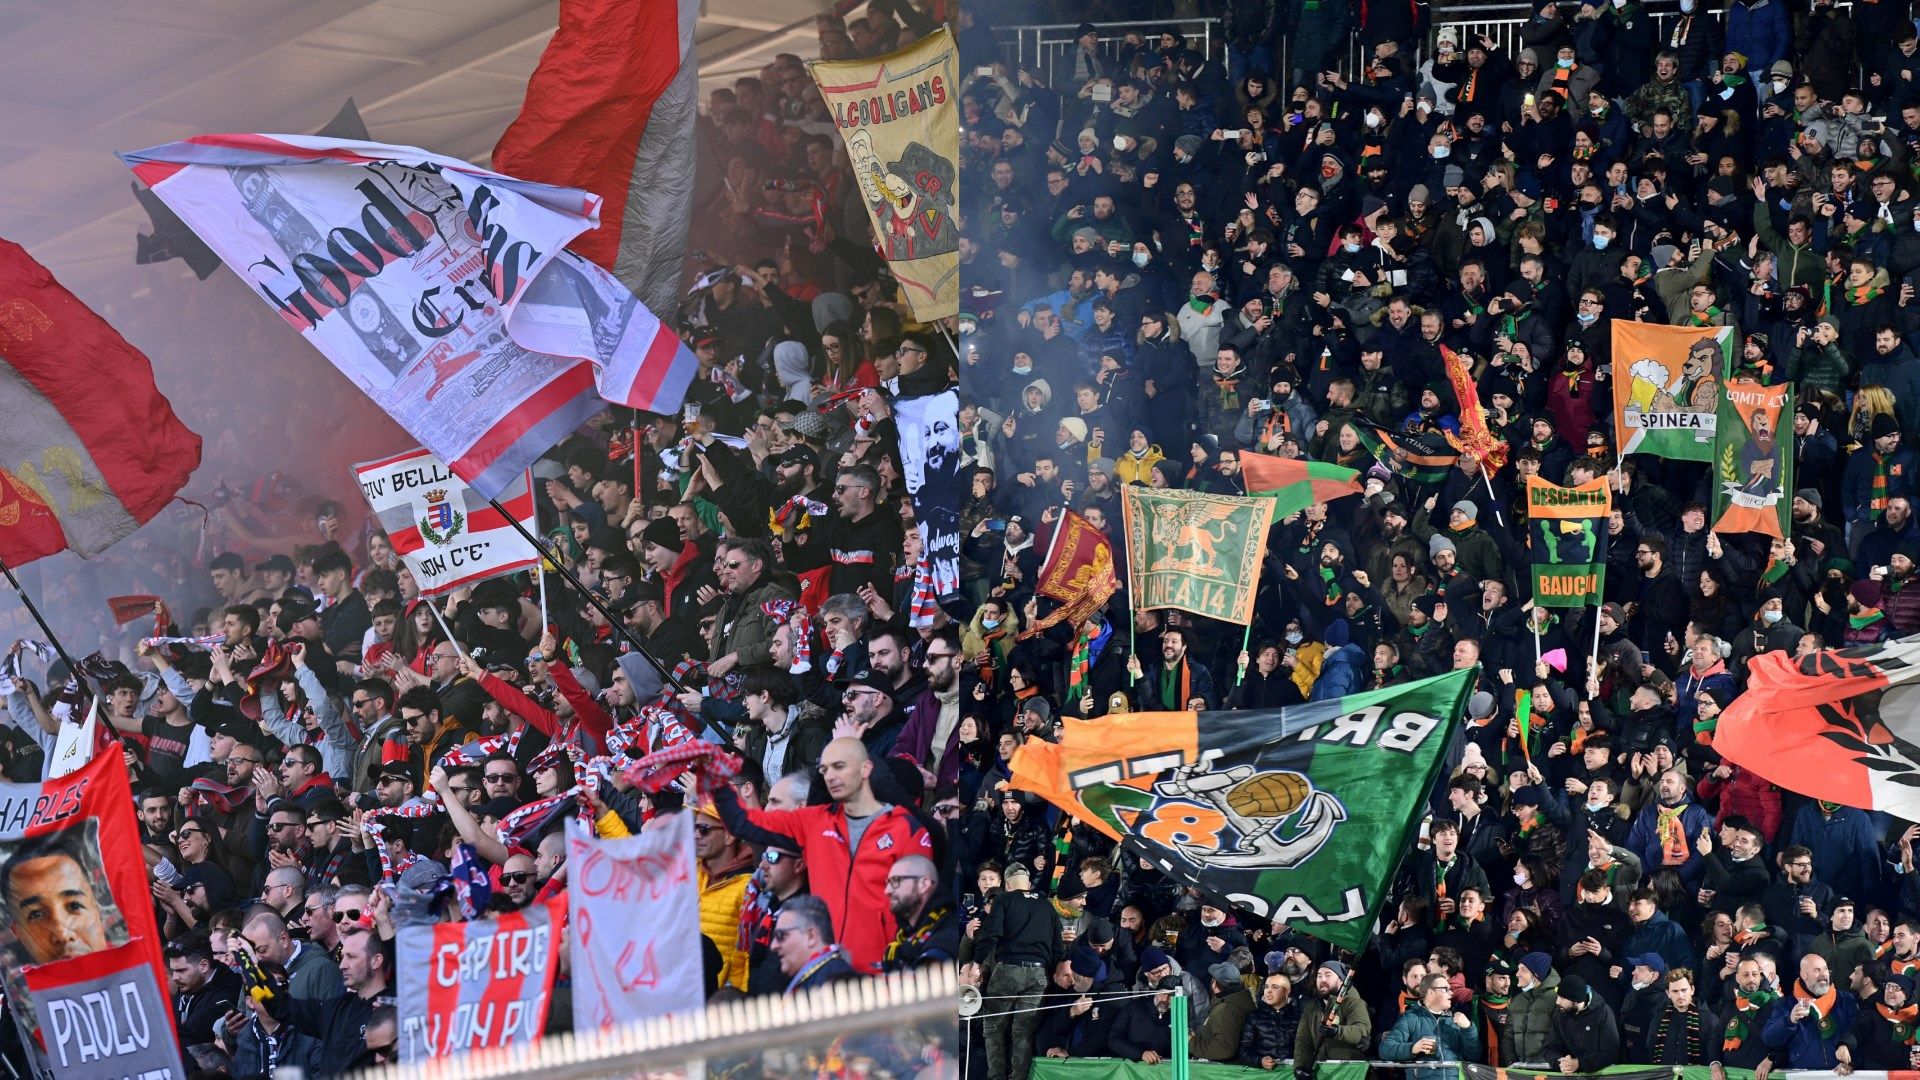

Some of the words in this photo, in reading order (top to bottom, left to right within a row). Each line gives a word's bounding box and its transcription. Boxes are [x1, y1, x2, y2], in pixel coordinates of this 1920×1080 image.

[247, 178, 431, 331] Good
[1640, 413, 1701, 428] SPINEA
[1704, 417, 1715, 425] 87
[391, 464, 454, 493] BELL
[1531, 485, 1607, 507] DESCANTA
[418, 554, 446, 579] NON
[1200, 582, 1226, 616] 14
[436, 924, 550, 988] CAPIRE
[46, 980, 151, 1068] PAOLO
